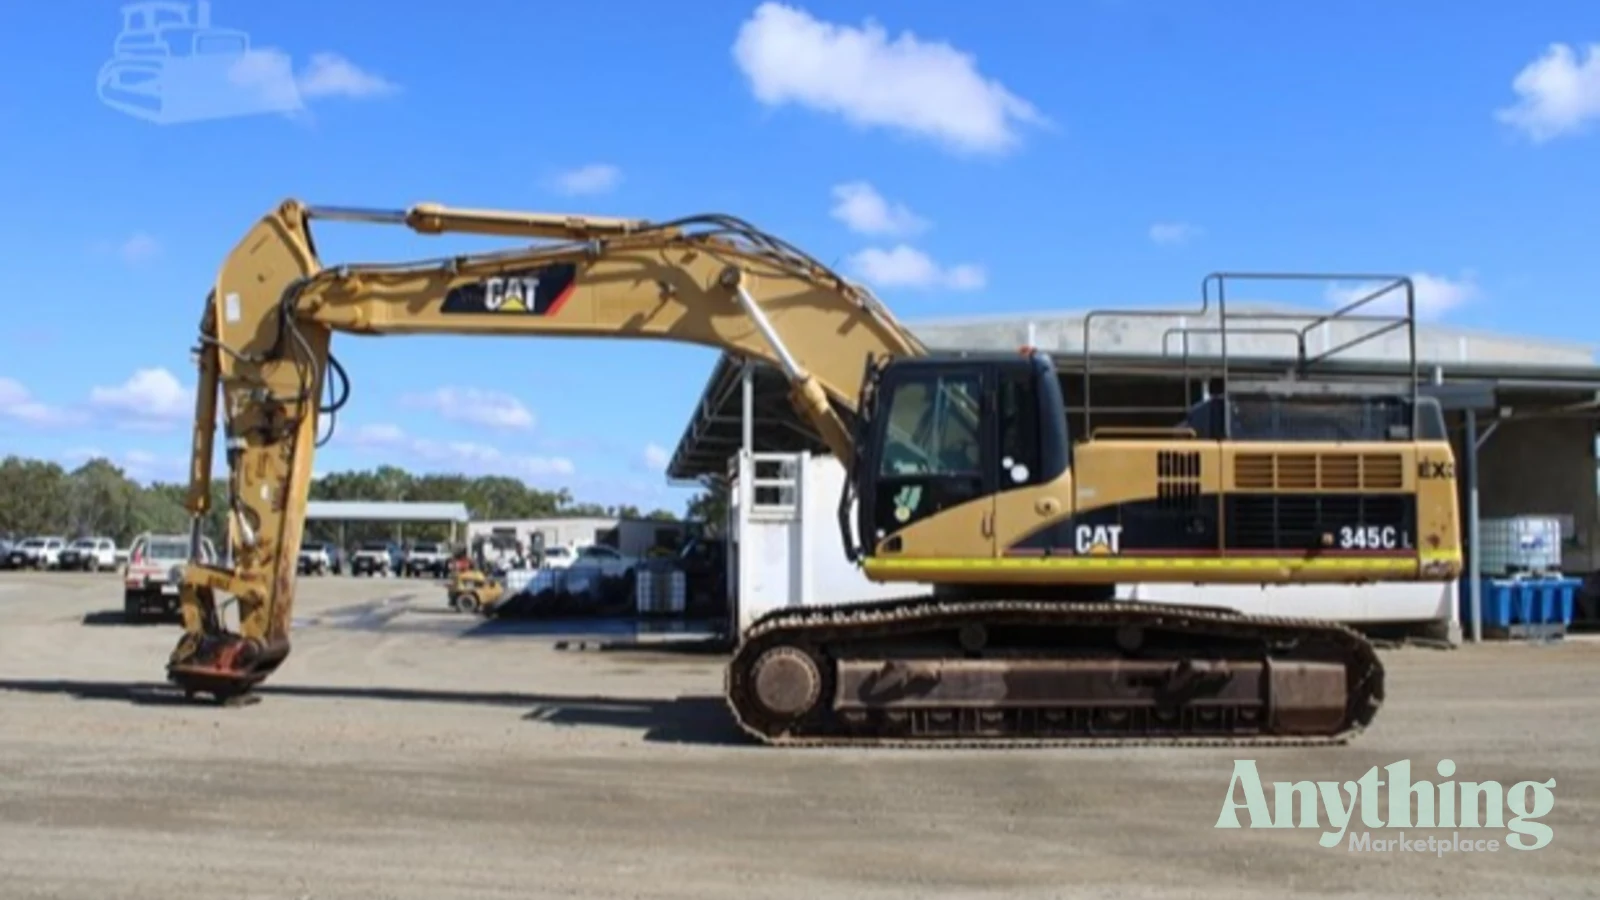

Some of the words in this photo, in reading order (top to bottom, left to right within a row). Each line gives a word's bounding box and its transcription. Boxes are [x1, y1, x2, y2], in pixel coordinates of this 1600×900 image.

[484, 277, 540, 311] CAT
[1075, 524, 1123, 555] CAT
[1339, 525, 1396, 549] 345C
